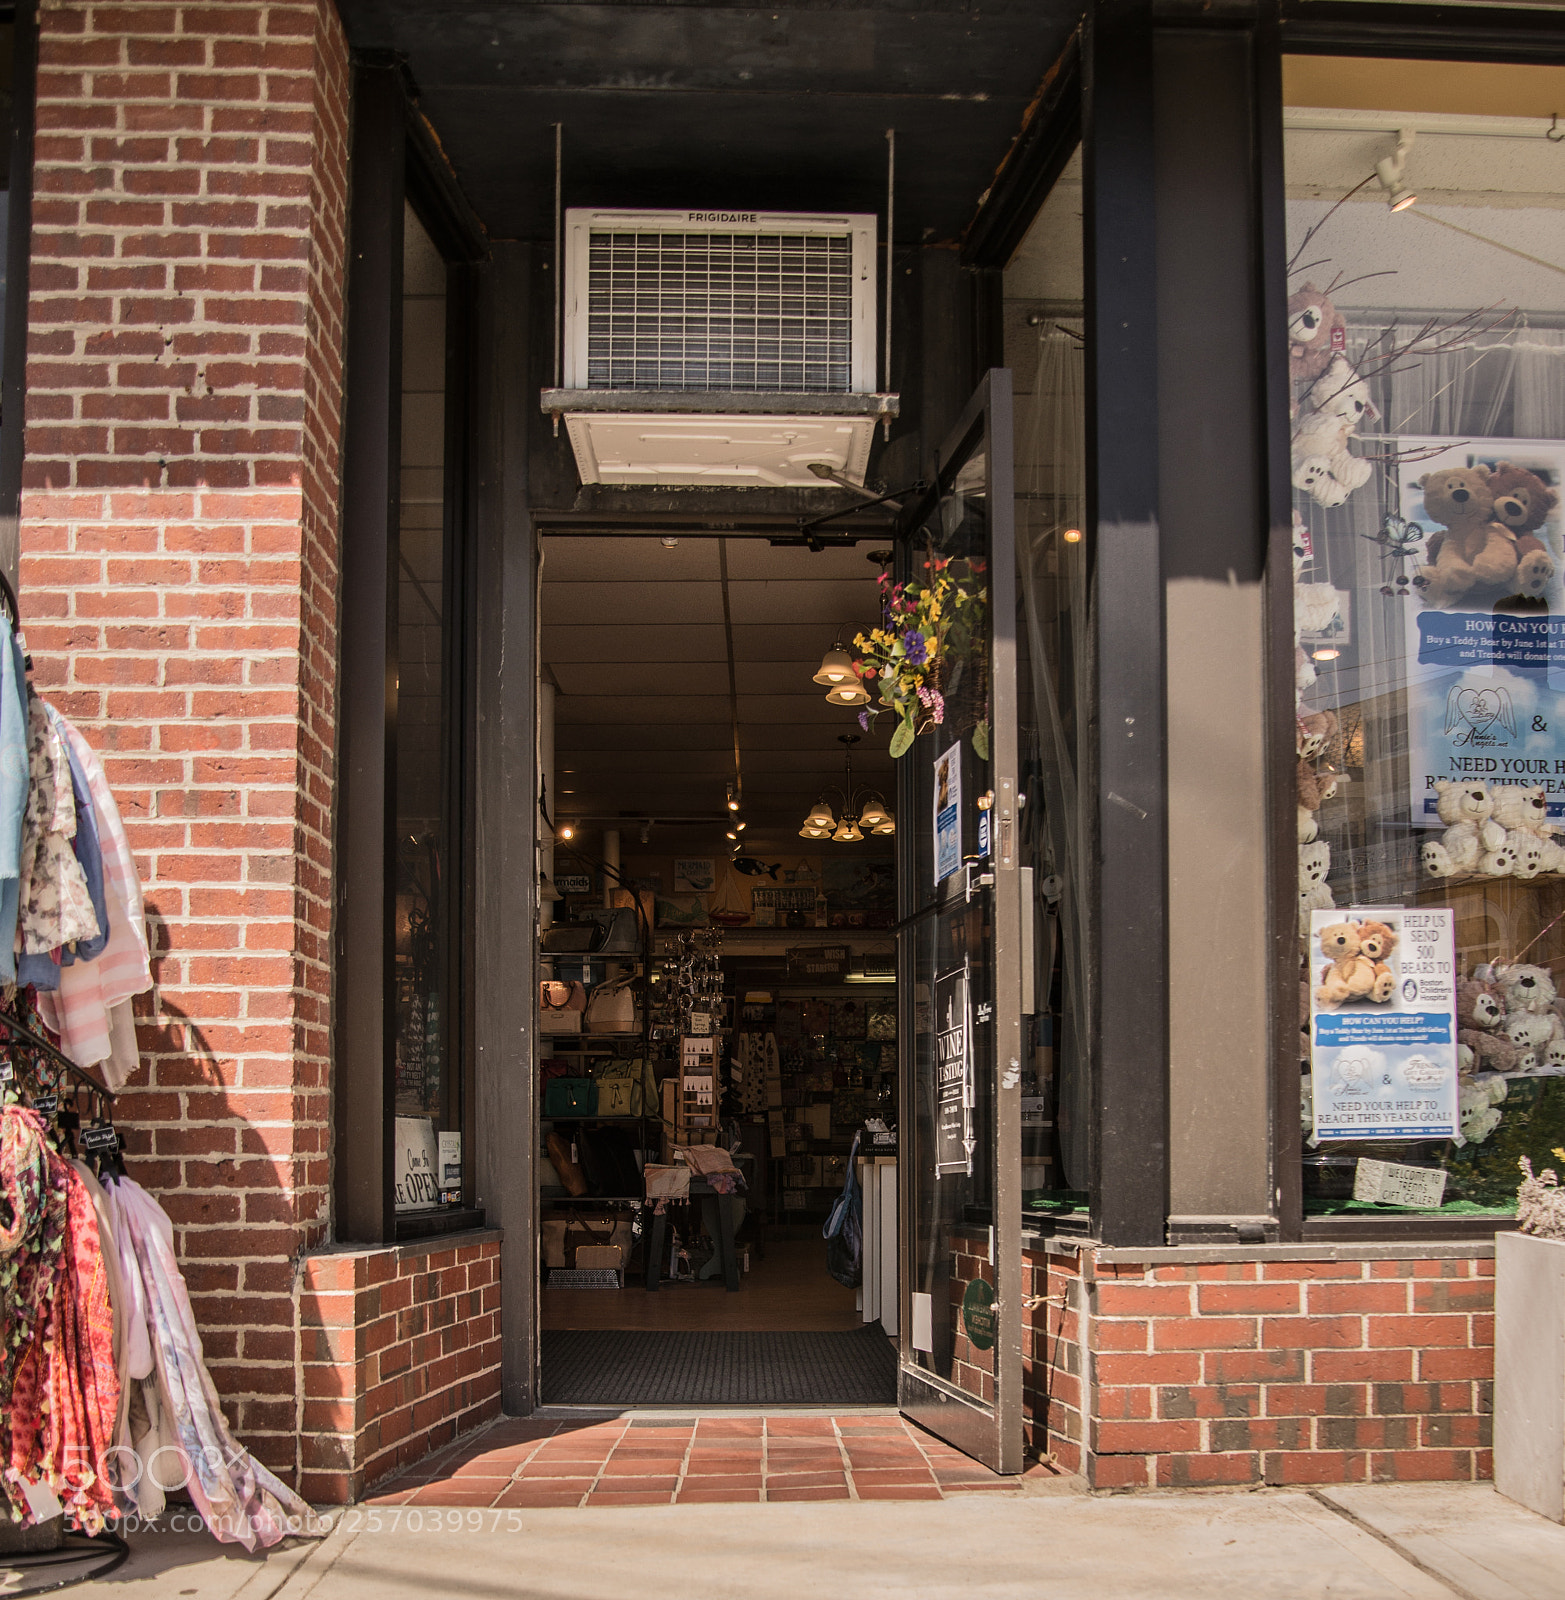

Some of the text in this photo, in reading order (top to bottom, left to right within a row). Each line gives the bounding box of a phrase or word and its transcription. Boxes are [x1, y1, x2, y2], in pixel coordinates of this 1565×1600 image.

[688, 212, 757, 223] FRIGIDAIRE
[1465, 620, 1497, 632] HOW
[1499, 621, 1528, 633] CAN
[1529, 623, 1560, 635] YOU
[1426, 635, 1445, 646] Buy
[1451, 636, 1479, 648] Teddy
[1480, 637, 1500, 646] Bear
[1501, 638, 1513, 649] by
[1514, 639, 1534, 648] June
[1535, 639, 1547, 648] 1st
[1548, 641, 1557, 649] at
[1459, 649, 1476, 658] and
[1477, 650, 1505, 660] Trends
[1507, 651, 1523, 660] will
[1523, 652, 1551, 661] donate
[1531, 715, 1548, 732] &
[1449, 757, 1498, 772] NEED
[1500, 758, 1551, 774] YOUR
[1403, 915, 1446, 928] HELP US
[1410, 930, 1440, 942] SEND
[1416, 945, 1435, 960] 500
[1400, 961, 1451, 974] BEARS TO
[1342, 1016, 1425, 1025] HOW CAN YOU HELP?
[938, 1030, 963, 1062] WINE
[1382, 1074, 1392, 1085] &
[1332, 1100, 1438, 1112] NEED YOUR HELP TO
[1318, 1112, 1452, 1124] REACH THIS YEARS GOAL!
[407, 1149, 421, 1171] Come
[1388, 1168, 1441, 1184] WELCOME TO
[405, 1173, 439, 1203] OPEN
[1399, 1180, 1428, 1194] TRENDS
[1382, 1190, 1400, 1200] GIFT
